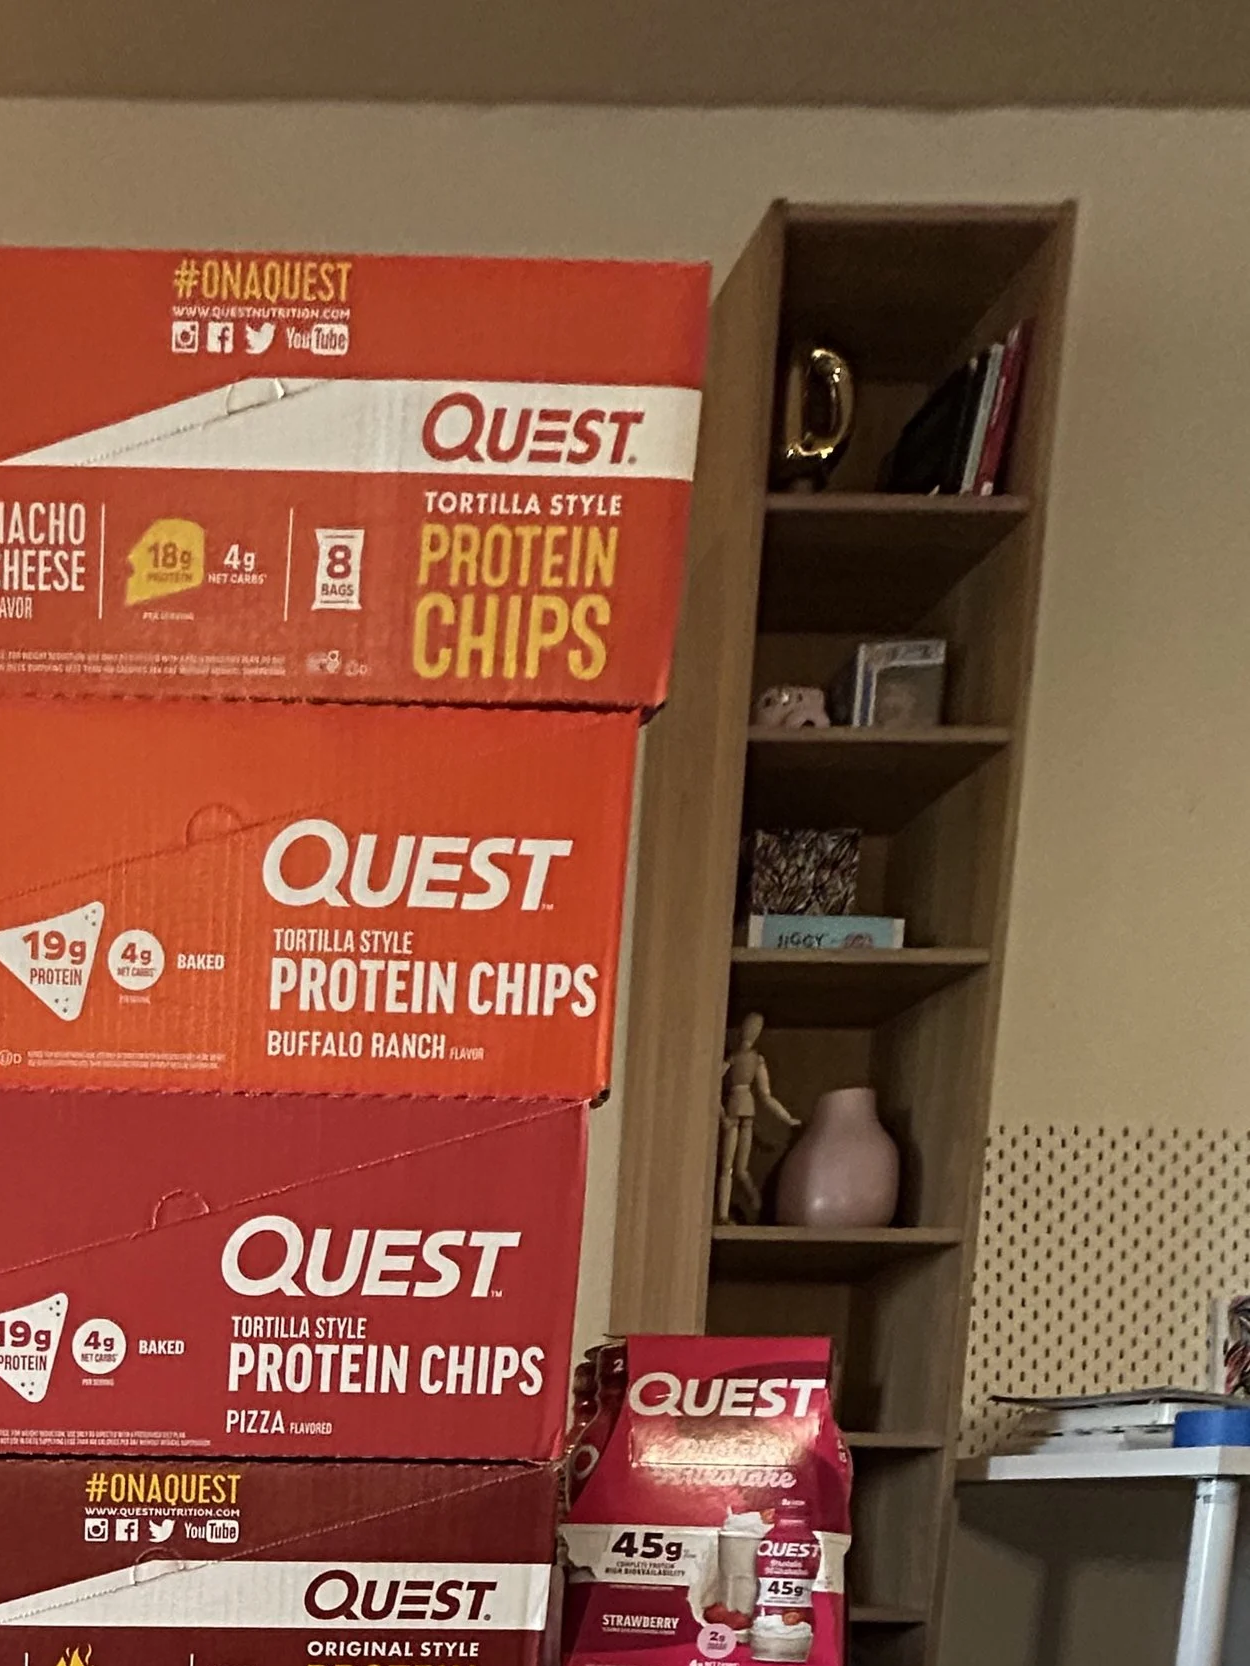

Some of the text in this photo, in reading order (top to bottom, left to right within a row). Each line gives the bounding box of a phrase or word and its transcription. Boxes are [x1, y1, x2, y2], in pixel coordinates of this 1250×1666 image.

[174, 262, 353, 304] #ONAQUEST
[422, 394, 646, 466] QUEST
[425, 490, 623, 517] TORTILLA STYLE
[326, 544, 353, 580] 8
[417, 523, 619, 589] PROTEIN
[321, 583, 354, 598] BAGS
[412, 596, 611, 682] CHIPS
[262, 819, 573, 910] QUEST
[21, 930, 88, 963] 19g
[274, 928, 413, 954] TORTILLA STYLE
[29, 966, 82, 986] PROTEIN
[177, 952, 224, 971] BAKED
[269, 960, 597, 1017] PROTEIN CHIPS
[267, 1030, 445, 1060] BUFFALO RANCH
[221, 1216, 521, 1297] QUEST
[85, 1331, 115, 1356] 4g
[232, 1316, 366, 1340] TORTILLA STYLE
[139, 1339, 185, 1356] BAKED
[229, 1344, 544, 1396] PROTEIN CHIPS
[630, 1372, 825, 1418] QUEST
[225, 1408, 286, 1434] PIZZA
[85, 1474, 240, 1505] #ONAQUEST
[612, 1531, 682, 1562] 45g
[303, 1570, 497, 1622] QUEST
[768, 1581, 803, 1597] 45g
[602, 1614, 679, 1629] STRAWBERRY
[307, 1641, 479, 1658] ORIGINAL STYLE
